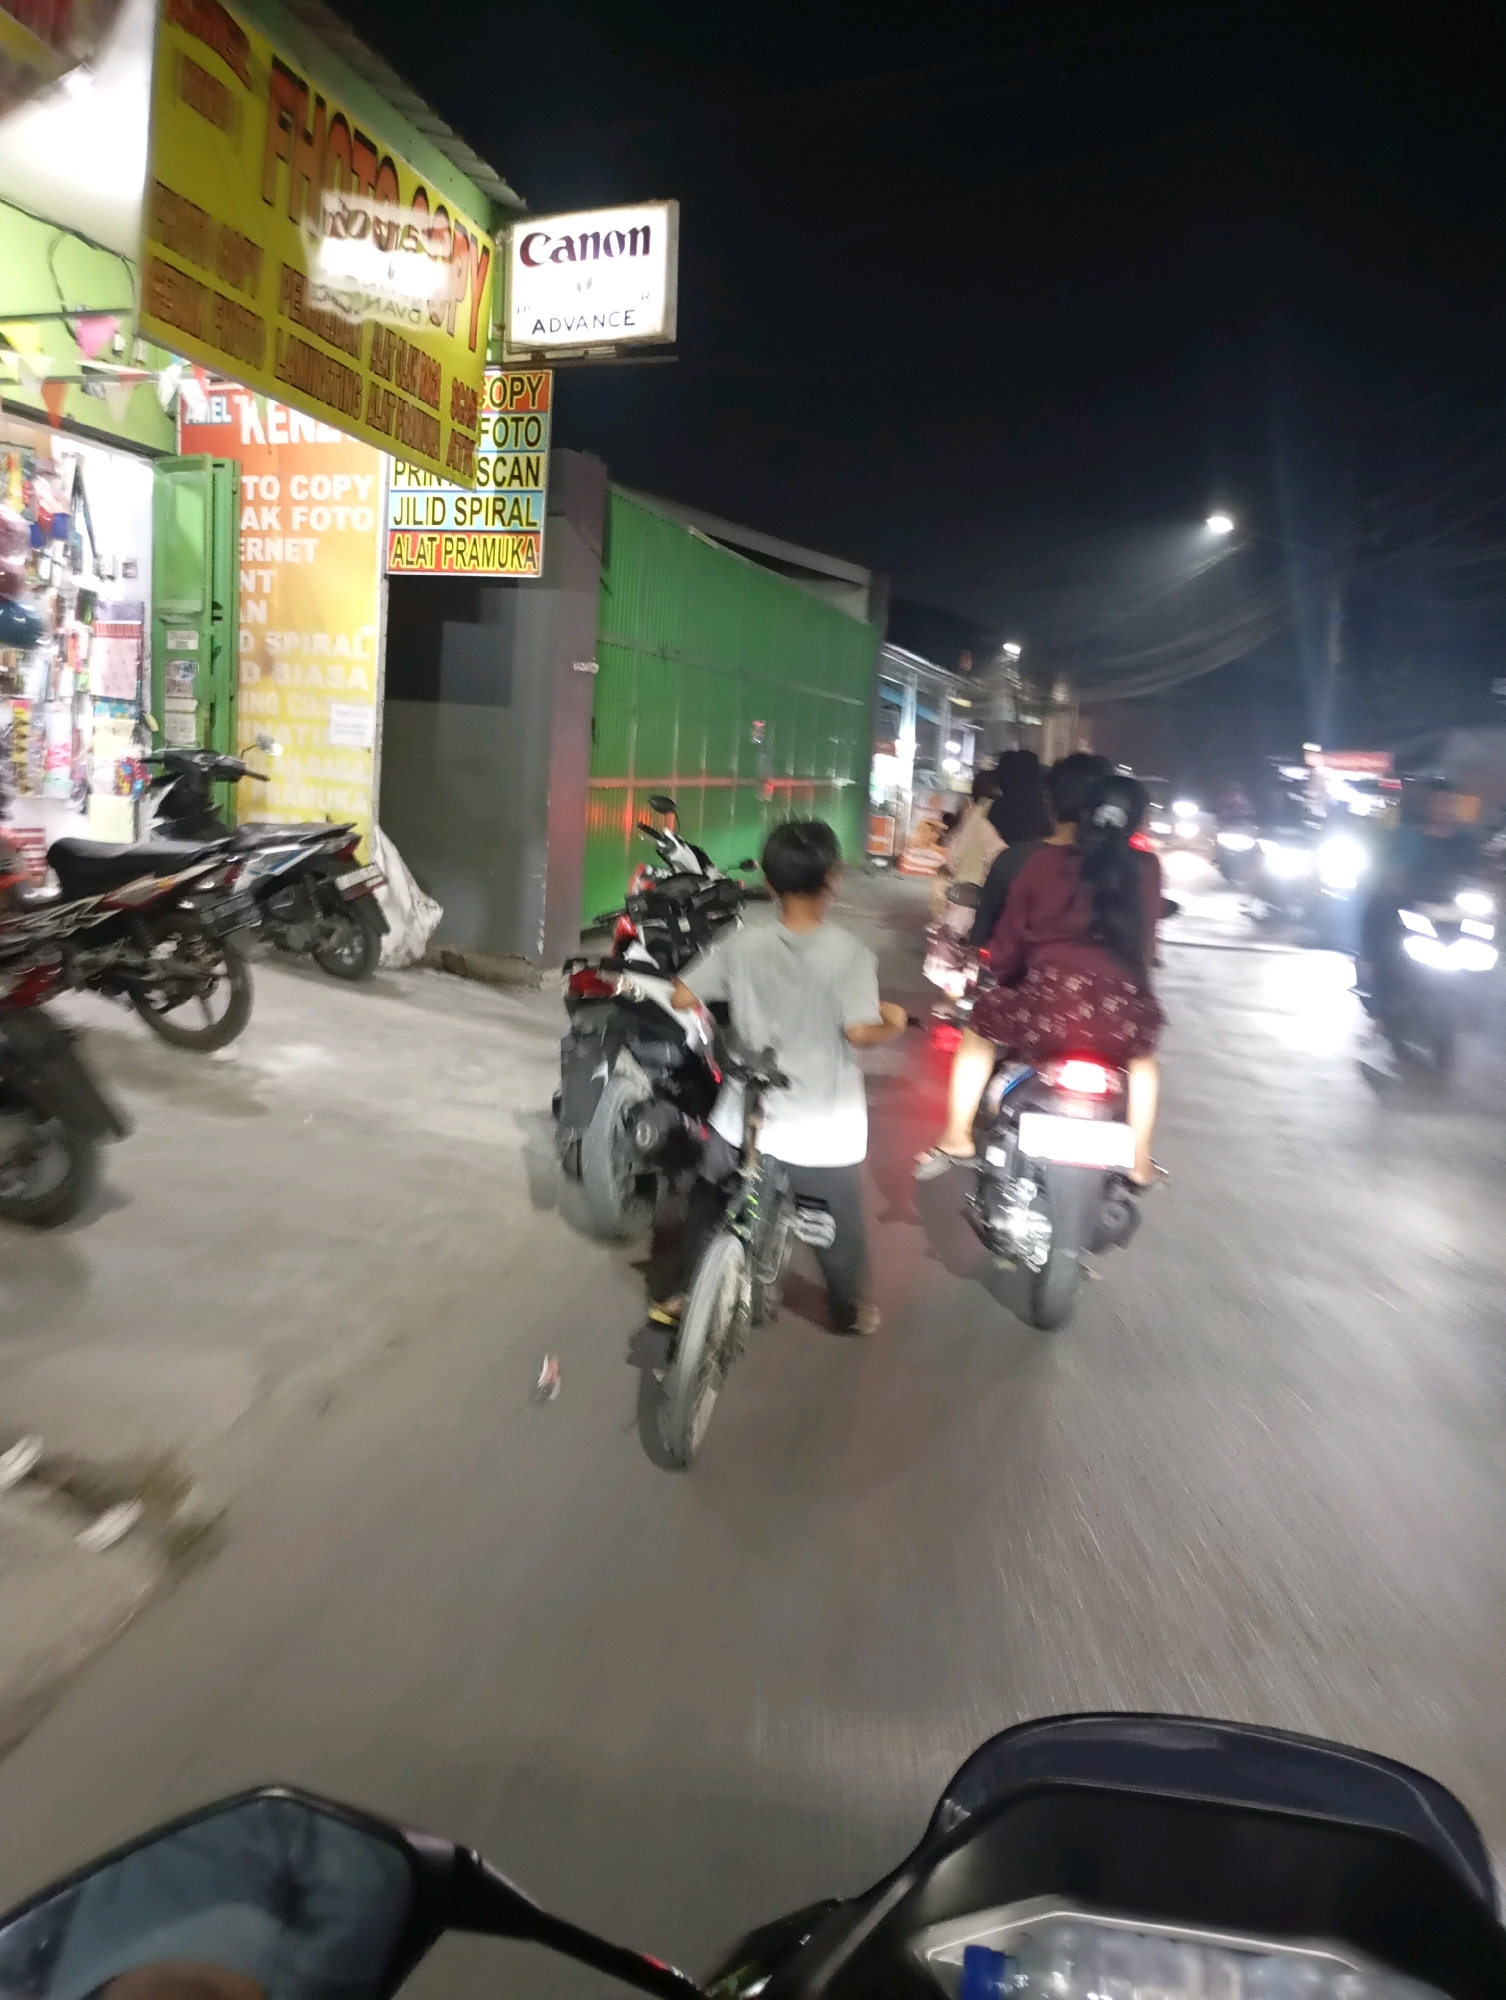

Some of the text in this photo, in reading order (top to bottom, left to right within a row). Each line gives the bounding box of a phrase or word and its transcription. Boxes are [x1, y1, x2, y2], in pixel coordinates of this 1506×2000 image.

[519, 225, 651, 268] Canon
[531, 309, 636, 335] ADVANCE
[479, 375, 543, 409] OPY
[233, 394, 357, 445] KEN
[394, 456, 540, 487] PRI SCAN
[290, 475, 374, 500] COPY
[292, 506, 375, 531] FOTO
[393, 496, 537, 527] JILID SPIRAL
[391, 535, 538, 570] ALAT PRAMUKA
